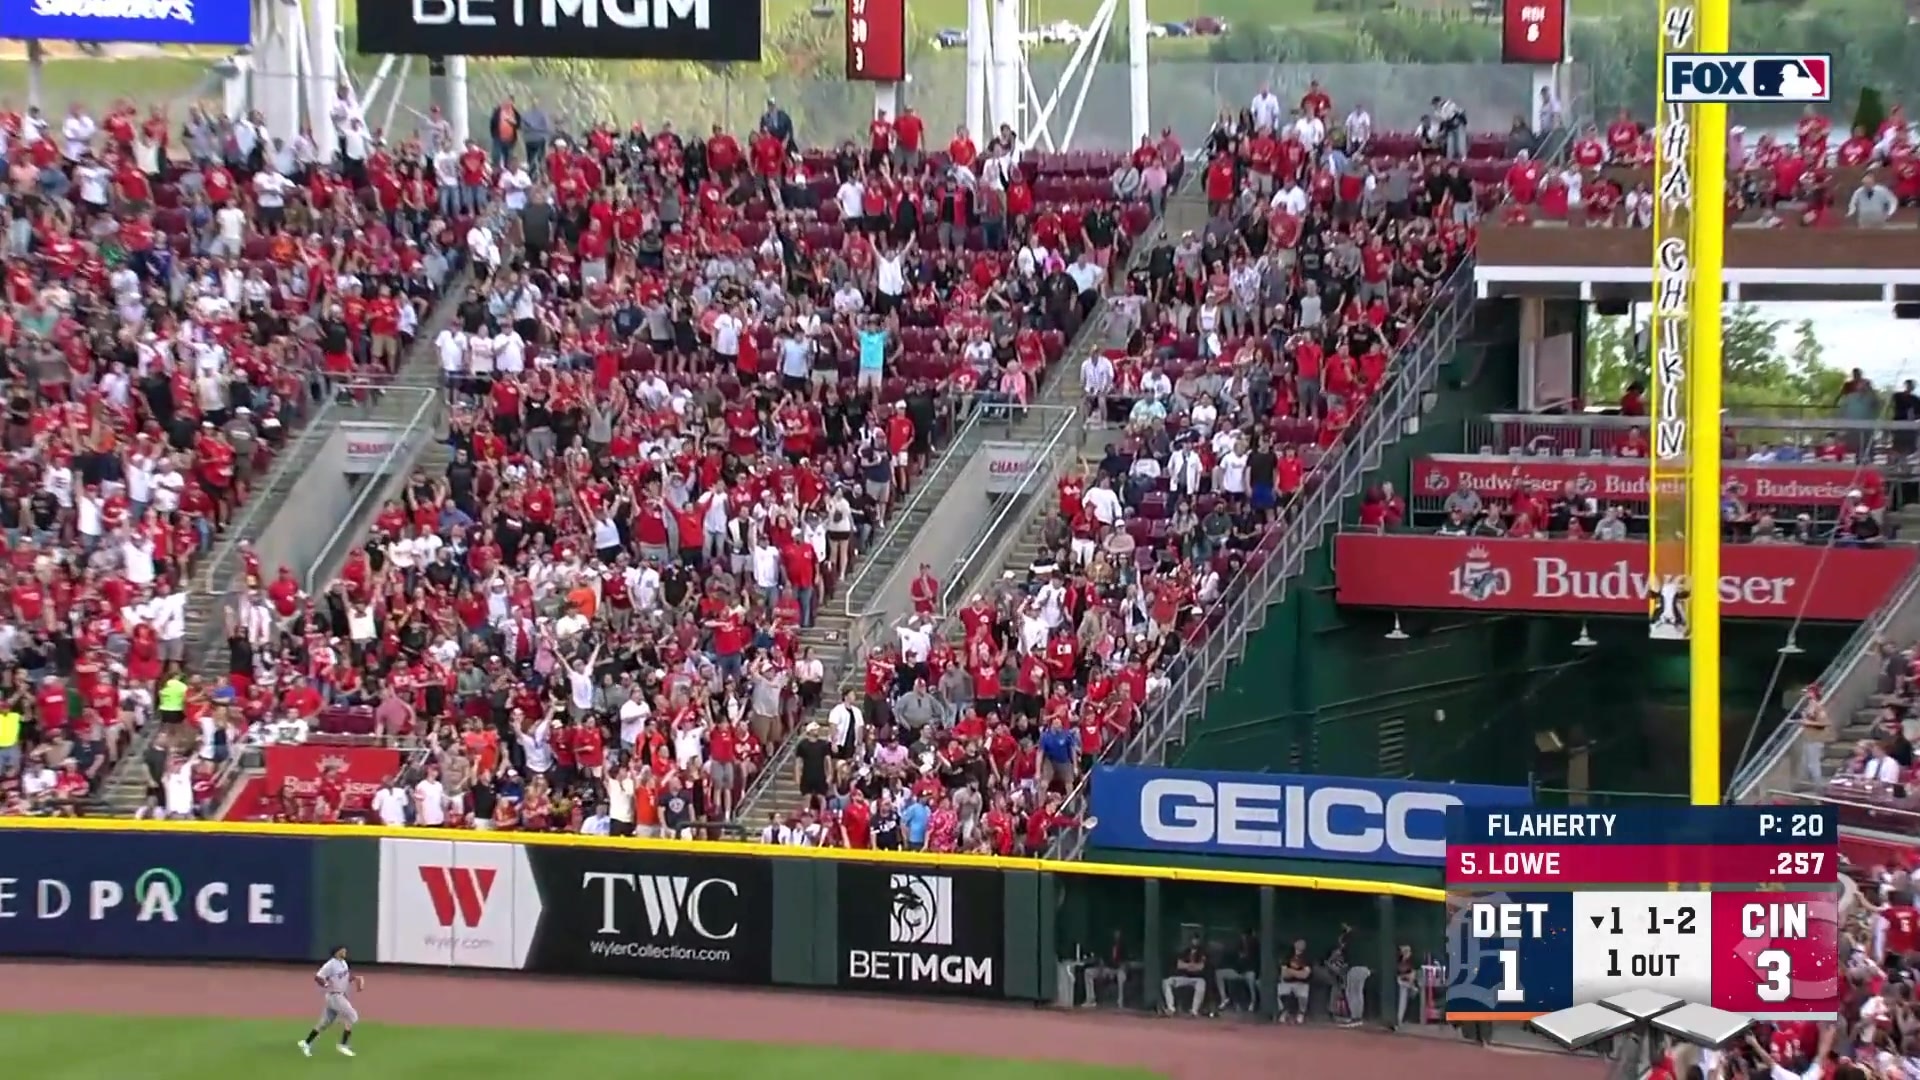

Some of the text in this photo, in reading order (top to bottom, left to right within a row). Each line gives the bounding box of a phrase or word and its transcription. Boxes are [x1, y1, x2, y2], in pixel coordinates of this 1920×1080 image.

[1658, 237, 1687, 458] CHIKIN
[1459, 471, 1562, 492] Budwiser
[1532, 557, 1795, 605] Budwser
[284, 776, 381, 795] Budiser
[582, 871, 738, 940] TWC
[590, 940, 731, 961] WylerCollection.com
[850, 950, 993, 986] BETMGM
